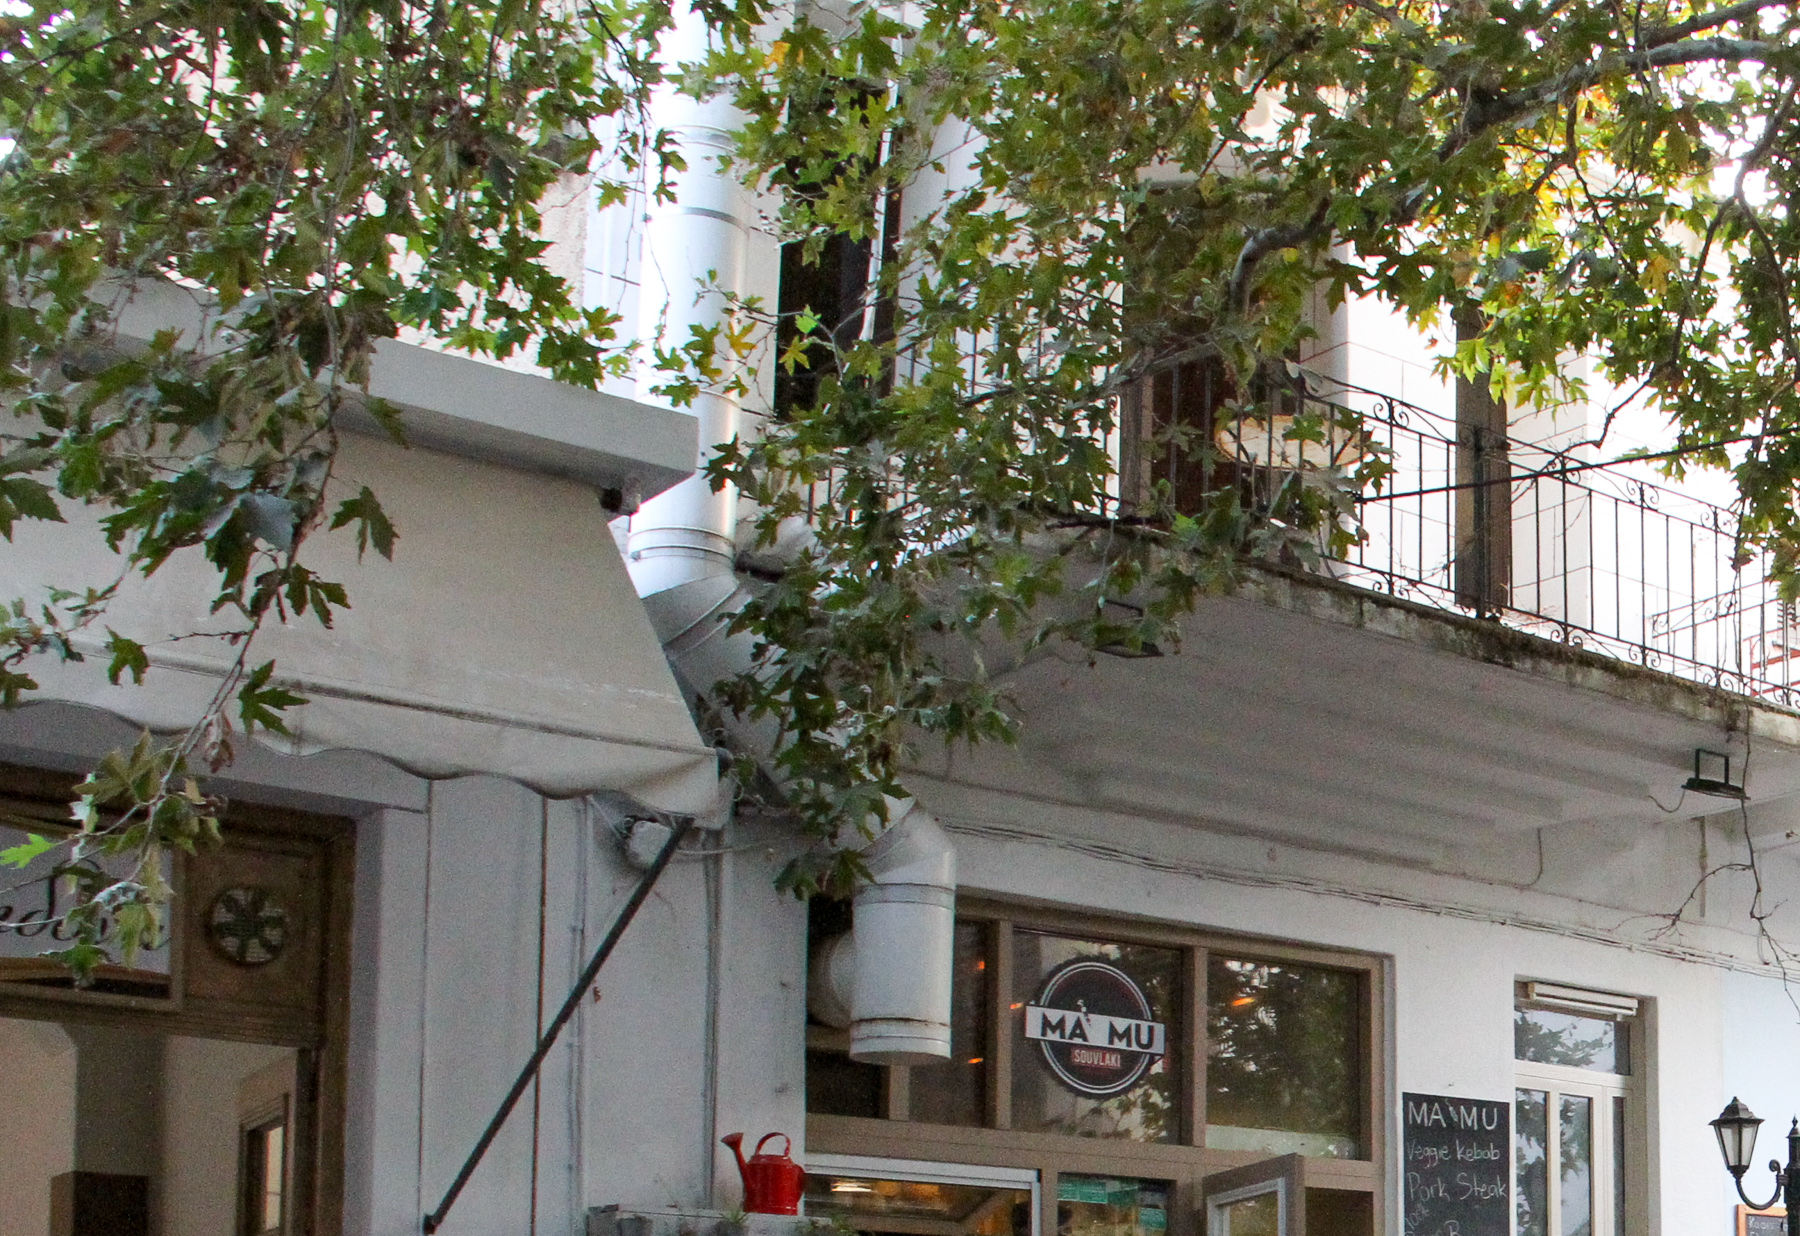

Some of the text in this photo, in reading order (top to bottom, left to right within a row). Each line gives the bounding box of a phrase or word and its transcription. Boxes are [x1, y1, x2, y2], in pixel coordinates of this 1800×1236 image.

[1108, 1020, 1155, 1050] MU
[1073, 1049, 1121, 1068] SOUVLAKI
[1460, 1105, 1498, 1131] MU
[1407, 1171, 1508, 1202] Pork Steak
